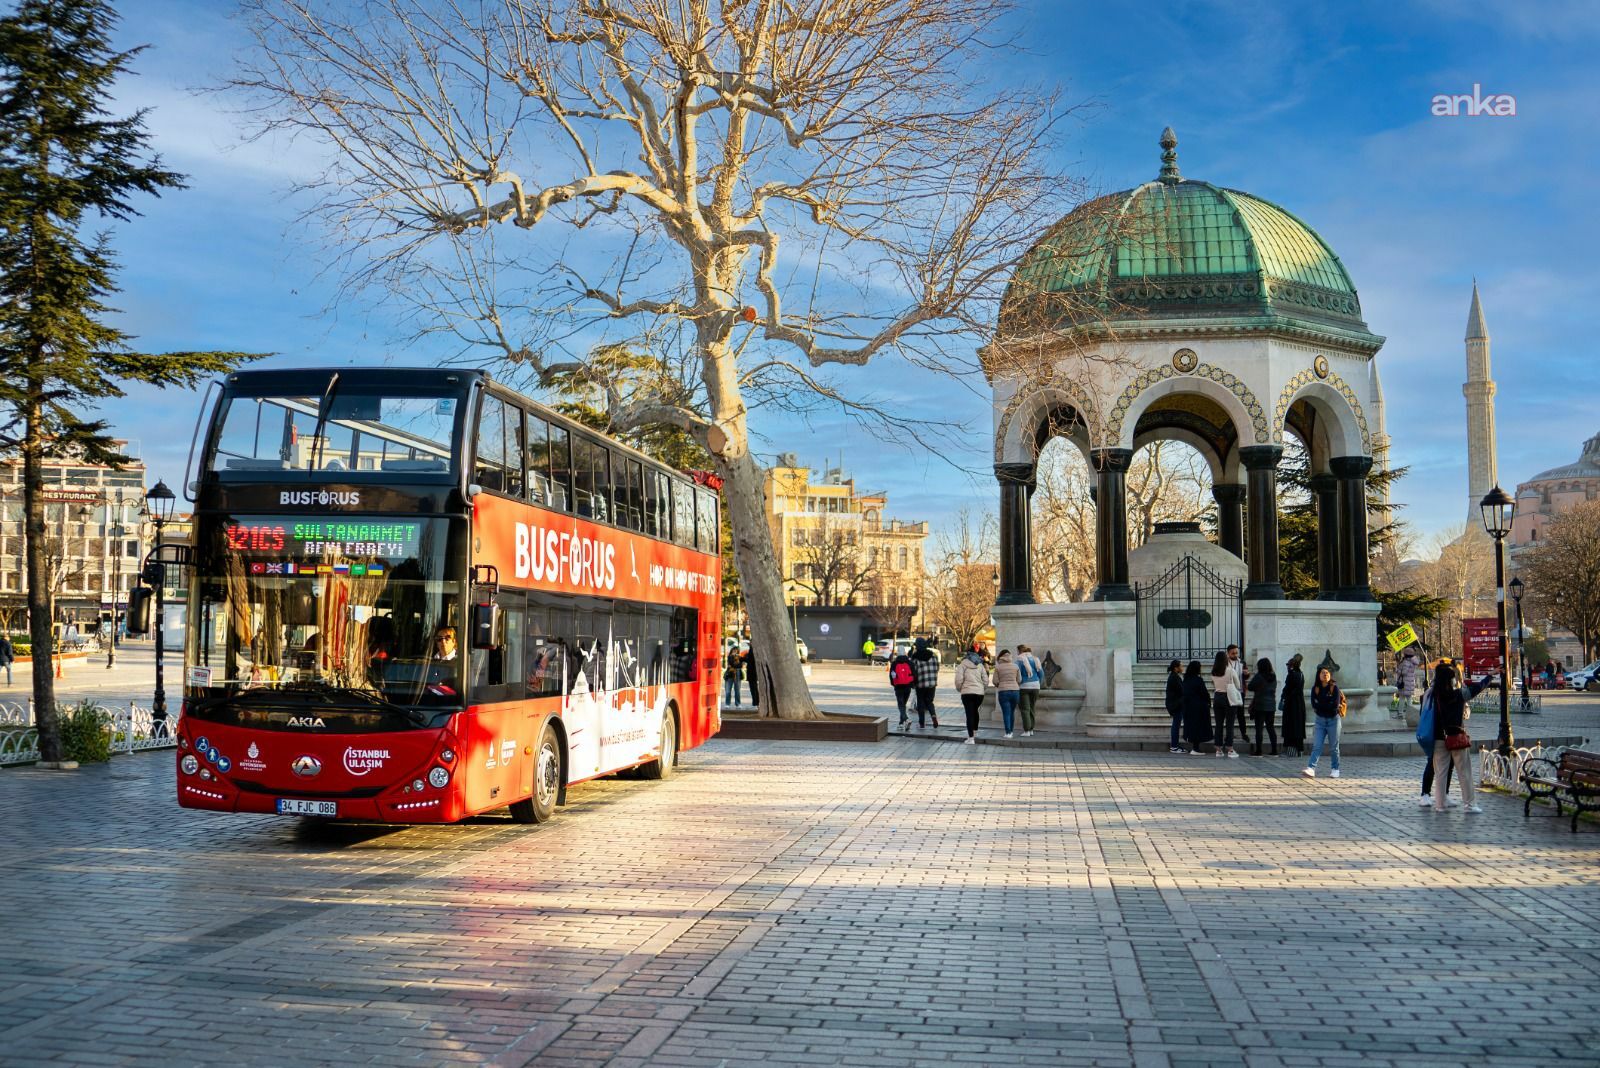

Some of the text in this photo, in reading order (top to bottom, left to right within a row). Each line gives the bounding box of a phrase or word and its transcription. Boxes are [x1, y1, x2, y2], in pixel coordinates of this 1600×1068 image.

[42, 492, 96, 500] RESTAURANT
[279, 491, 360, 505] BUSFORUS
[294, 523, 415, 541] SULTANAHMET
[515, 518, 615, 591] BUSFORUS
[649, 563, 716, 595] HOP ON HOP OFF TOURS
[287, 716, 326, 728] AKIA
[282, 800, 335, 814] 34 FJC 086
